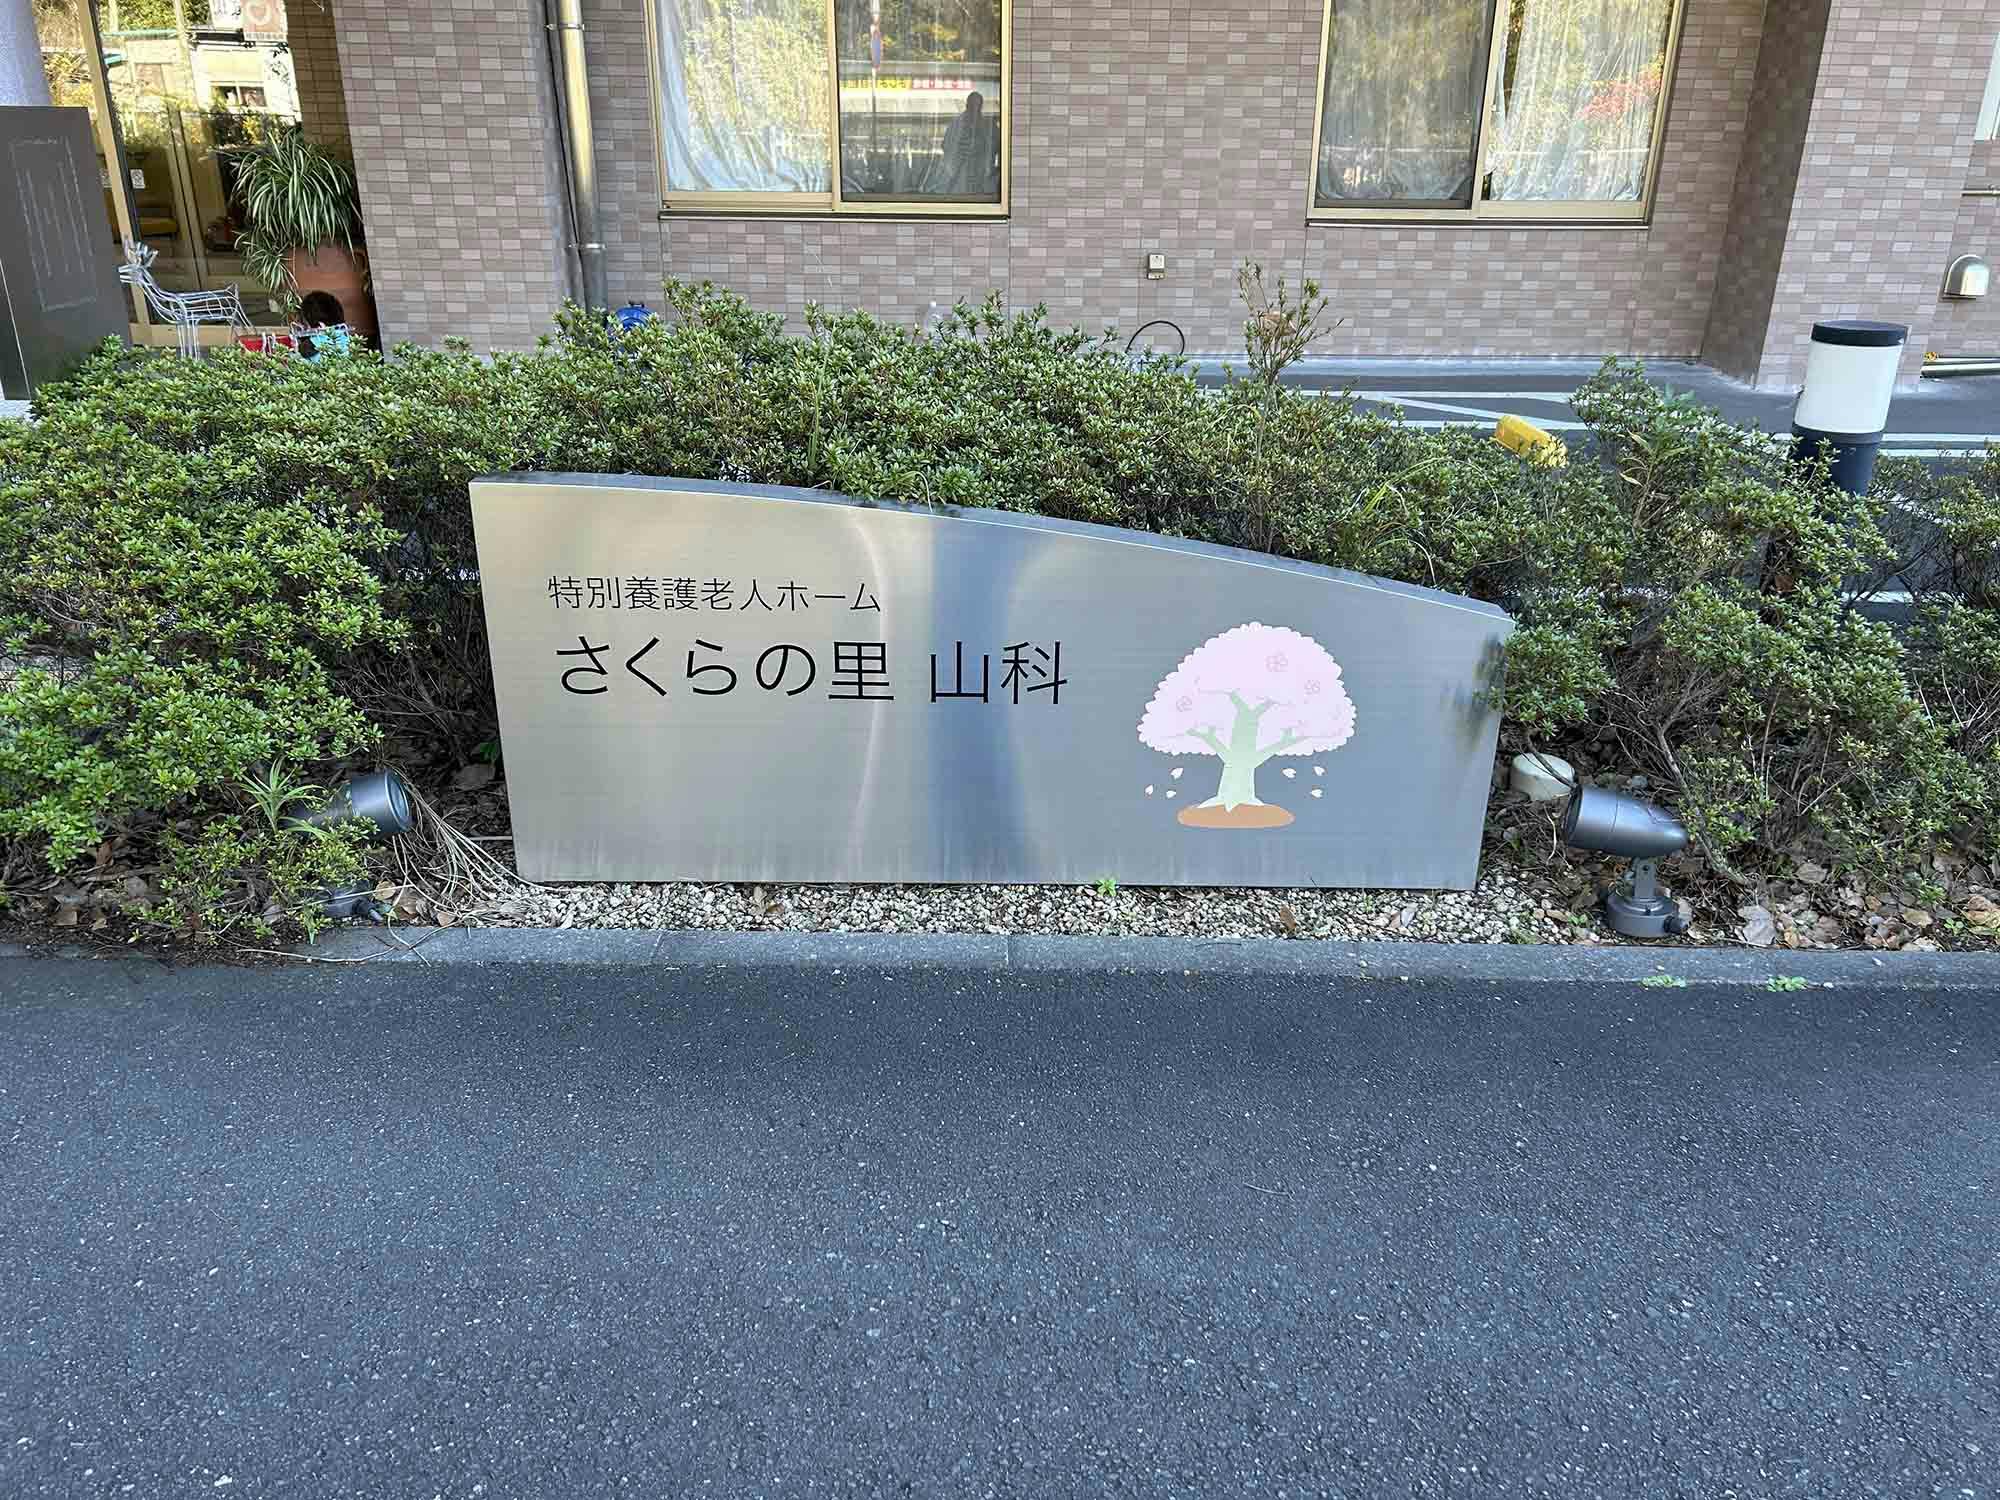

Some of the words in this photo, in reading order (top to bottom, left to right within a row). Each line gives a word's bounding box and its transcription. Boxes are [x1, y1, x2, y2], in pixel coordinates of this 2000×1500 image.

[548, 576, 881, 613] 特別養護老人ホーム
[556, 636, 895, 701] さくらの里
[929, 640, 1068, 705] 山科
